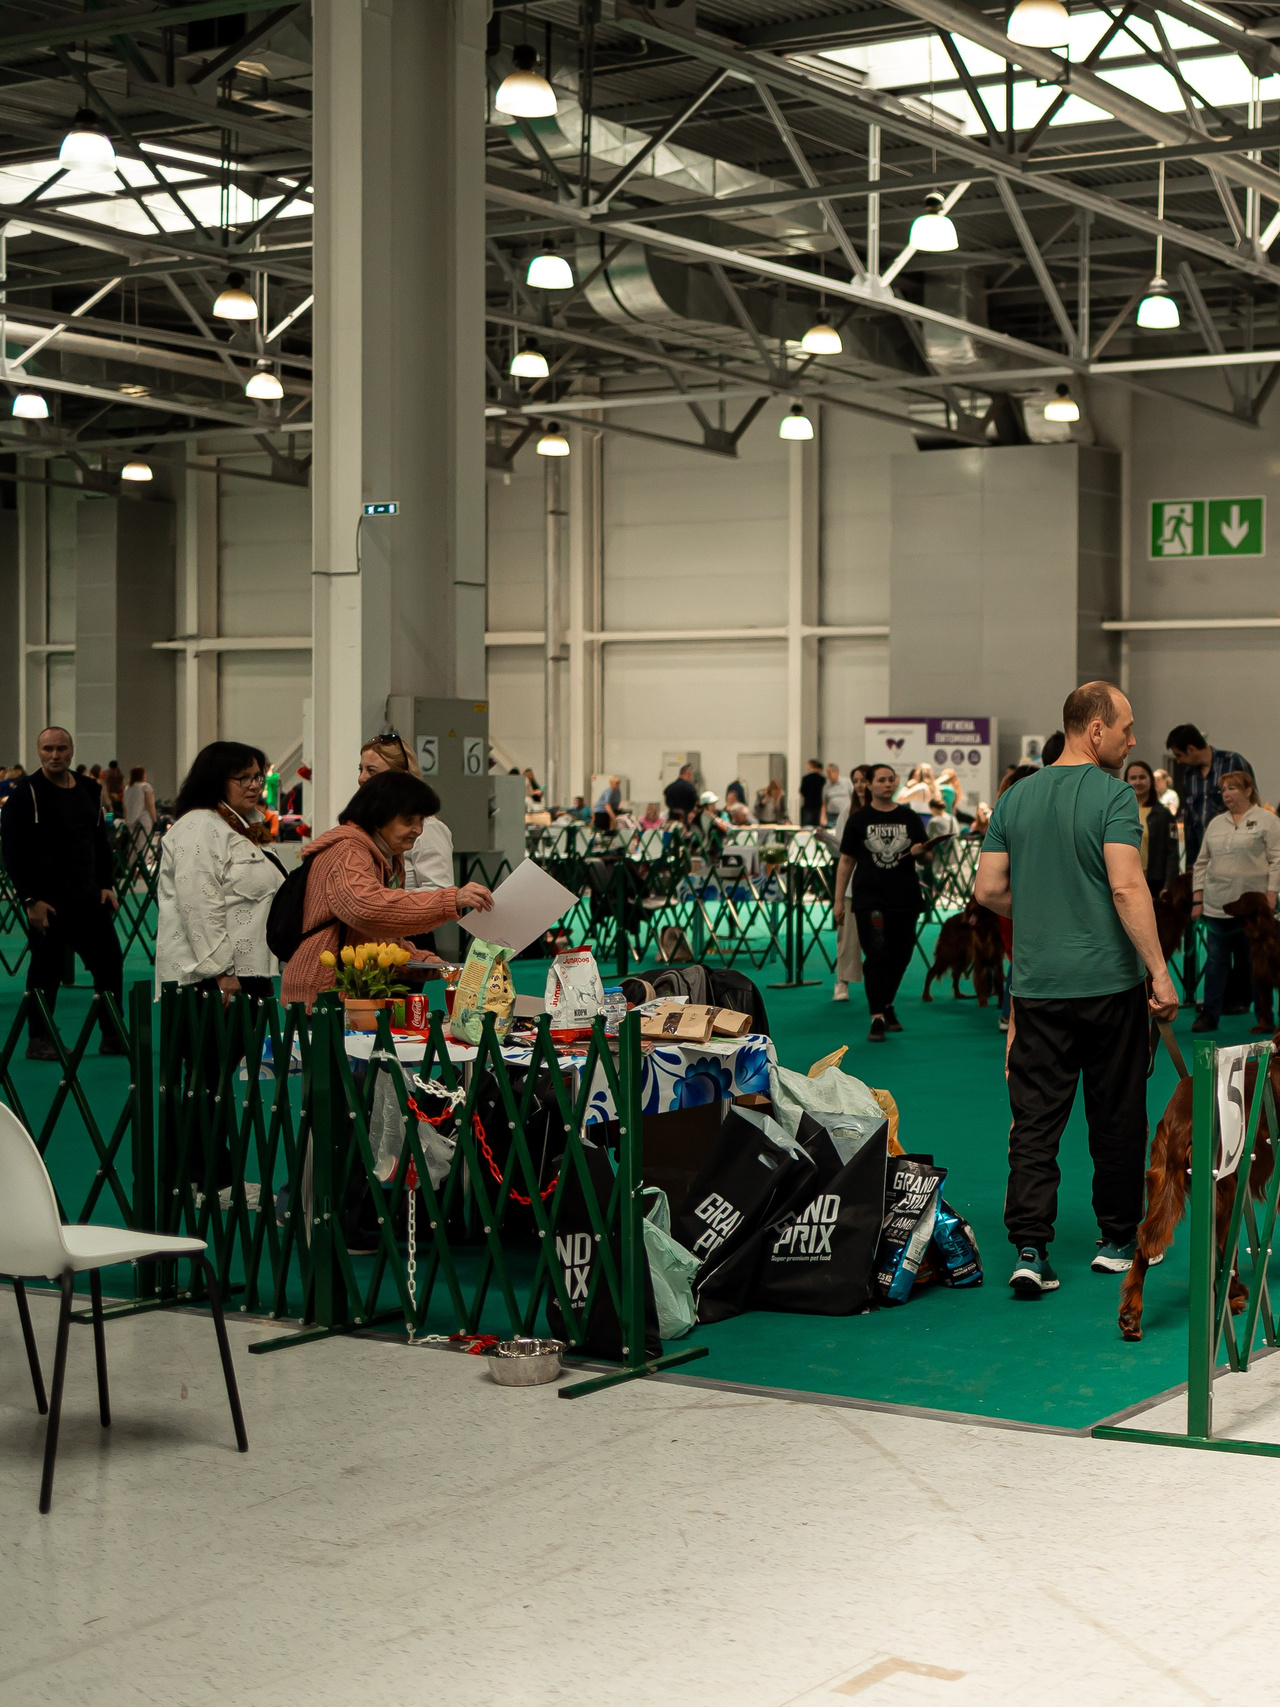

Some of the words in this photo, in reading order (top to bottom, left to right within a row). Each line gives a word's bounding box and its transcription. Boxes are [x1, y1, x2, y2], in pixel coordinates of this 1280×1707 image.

[941, 719, 976, 731] ГИГИЕНА
[935, 733, 982, 744] ПИТОМНИКА
[421, 740, 436, 772] 5
[467, 742, 481, 774] 6
[867, 824, 907, 837] CUSTOM
[1225, 1056, 1244, 1168] 5
[893, 1172, 940, 1194] GRAND
[898, 1193, 931, 1210] PRIX
[773, 1225, 836, 1253] PRIX
